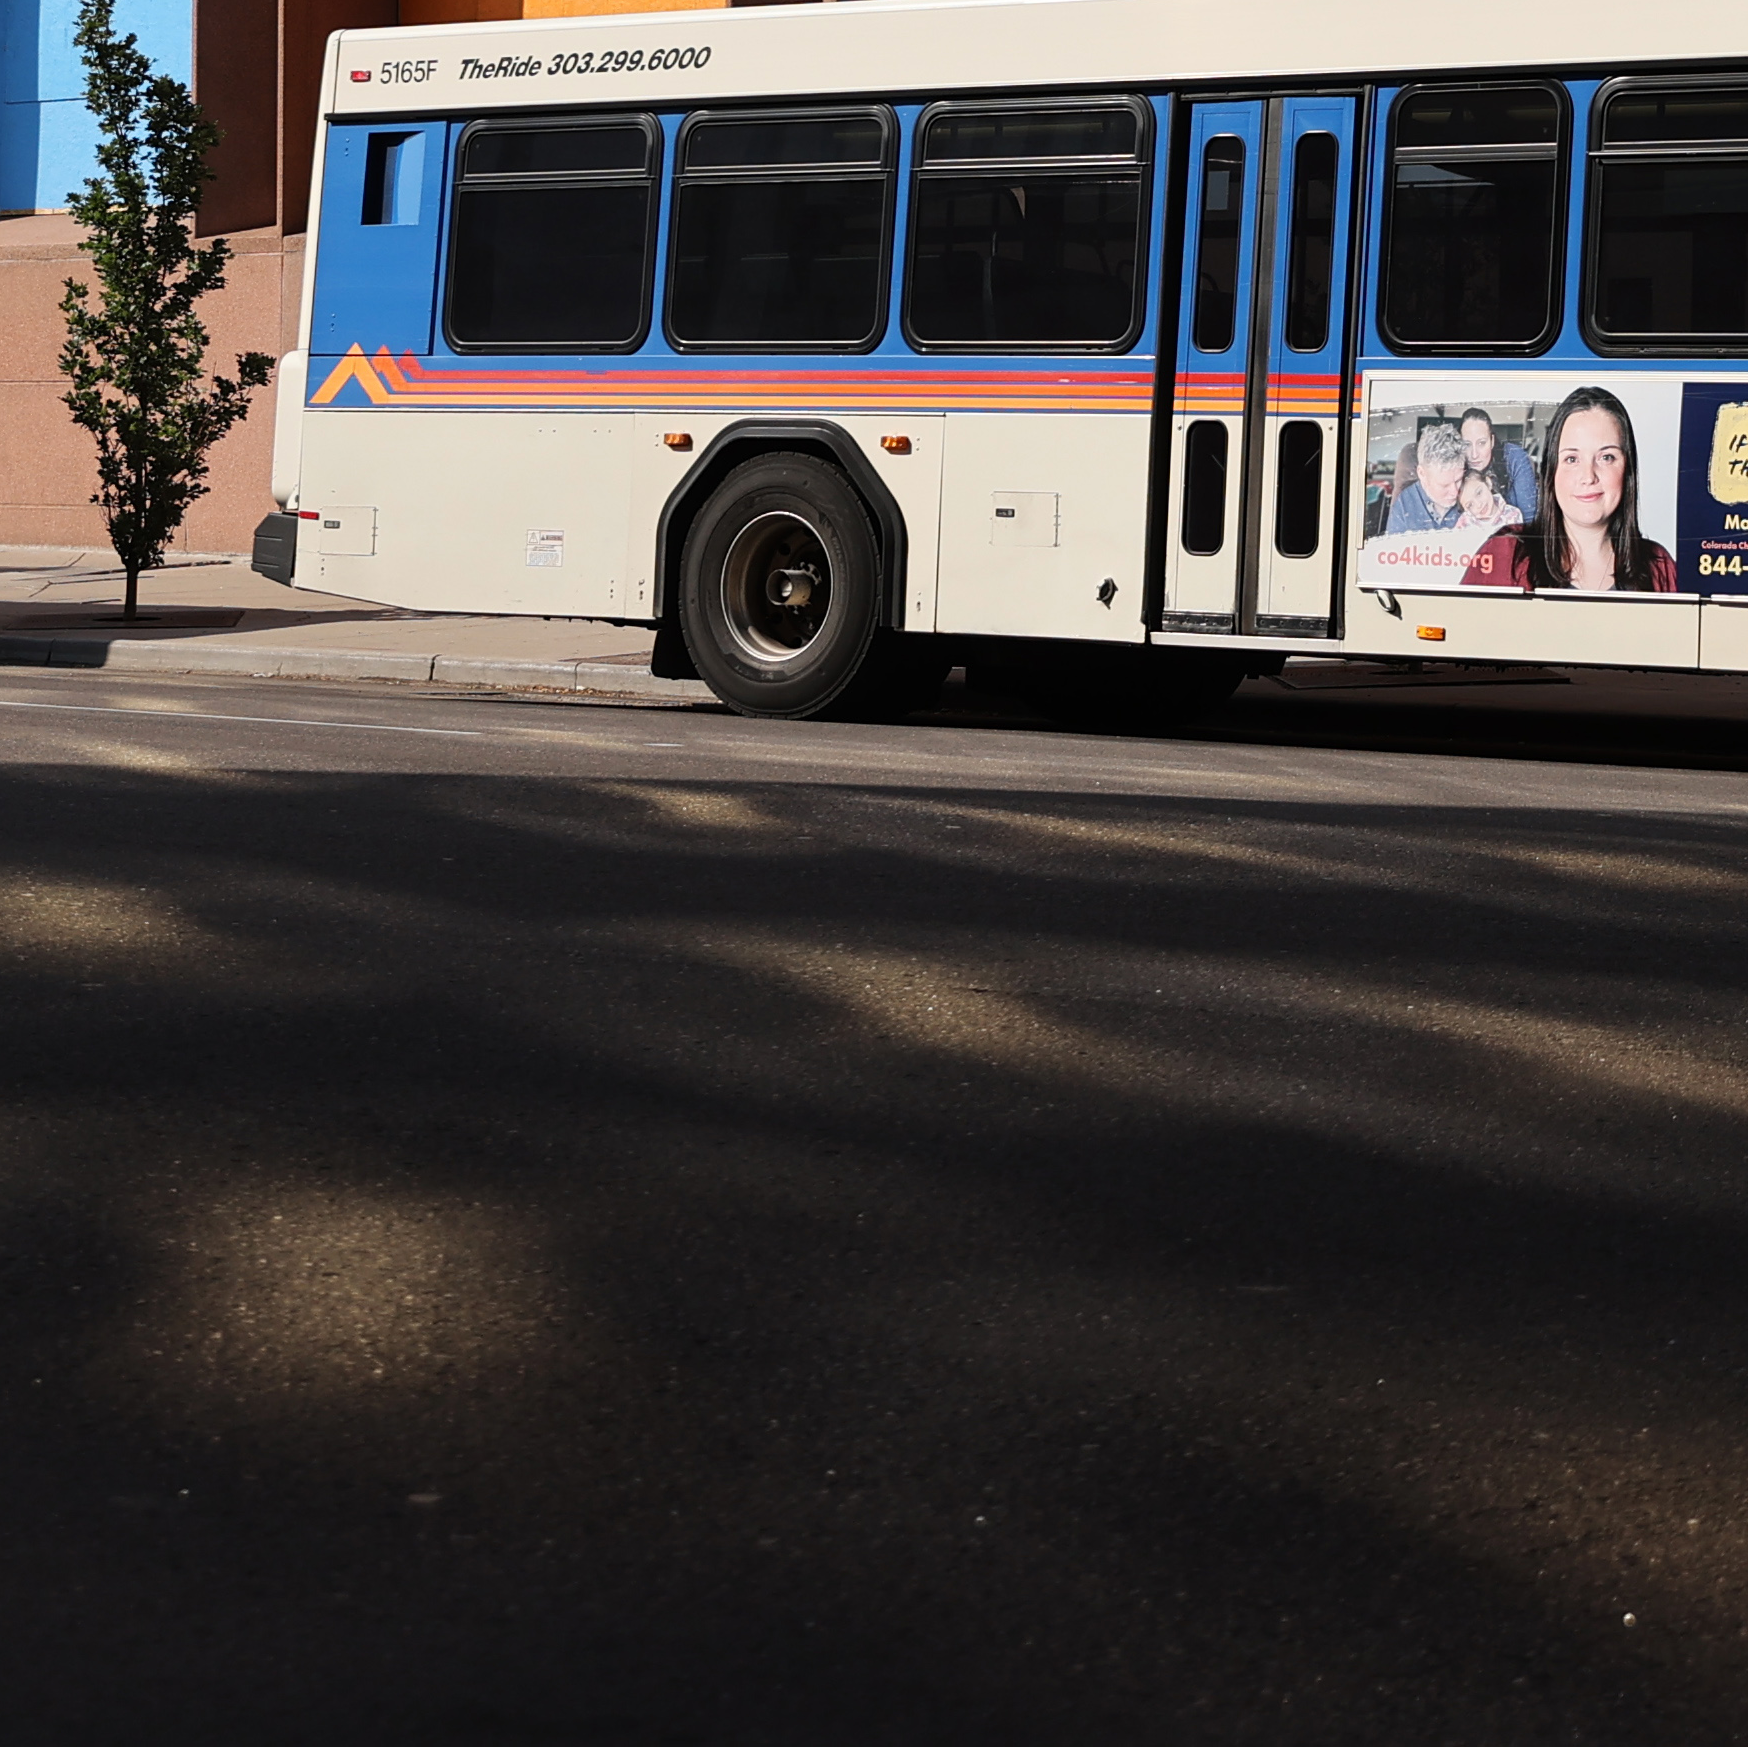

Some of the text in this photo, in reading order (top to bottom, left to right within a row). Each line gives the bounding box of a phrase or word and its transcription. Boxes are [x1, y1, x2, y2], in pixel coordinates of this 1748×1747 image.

[379, 59, 439, 85] 5165F
[458, 46, 712, 81] TheRide 303.299.6000
[1701, 540, 1738, 550] Colorado
[1377, 545, 1493, 574] co4kids.org
